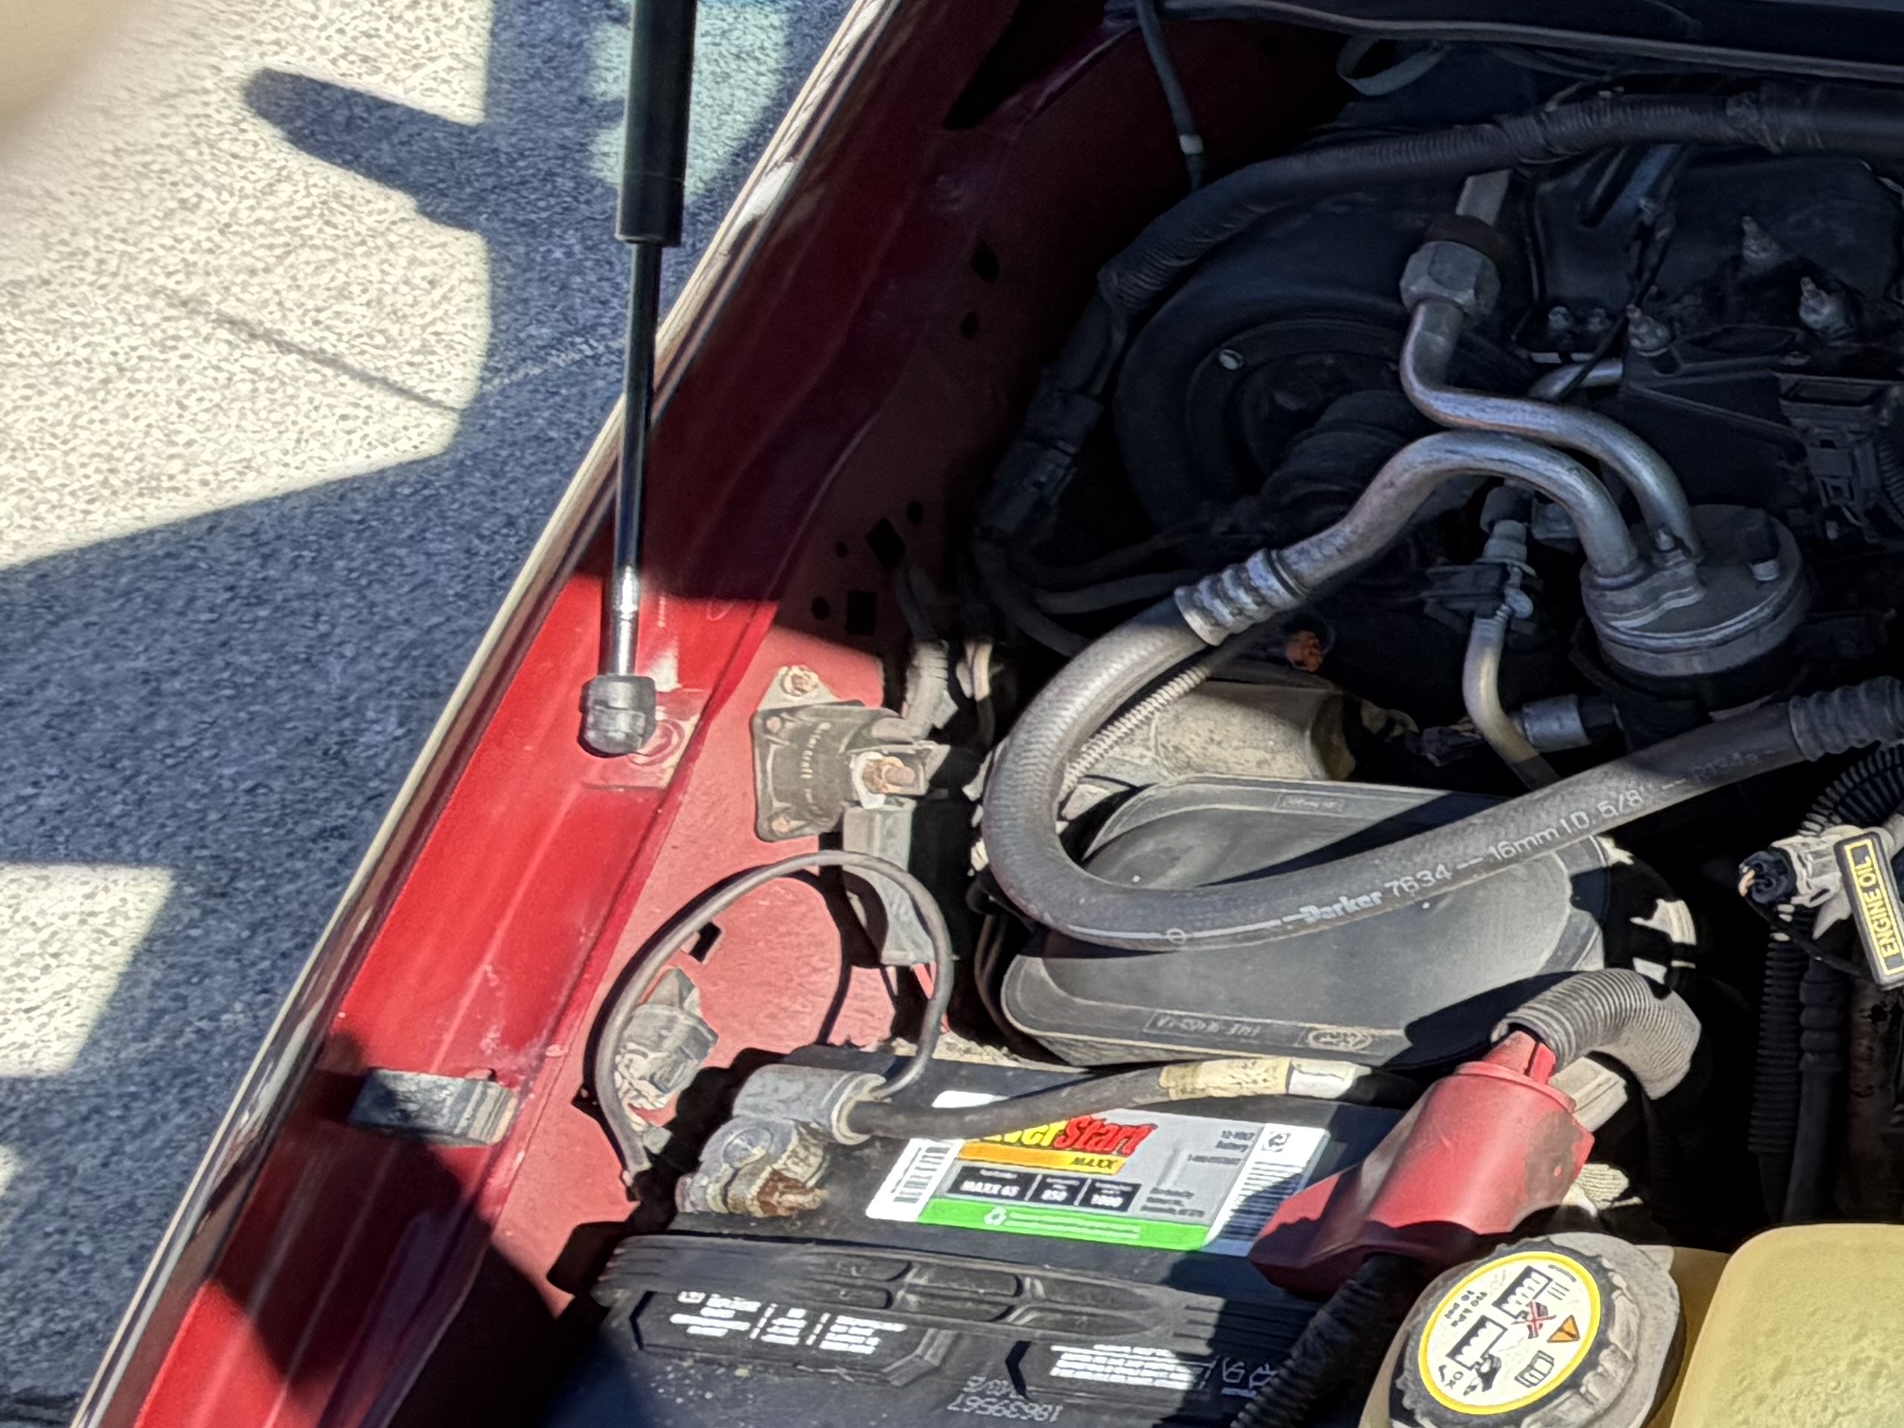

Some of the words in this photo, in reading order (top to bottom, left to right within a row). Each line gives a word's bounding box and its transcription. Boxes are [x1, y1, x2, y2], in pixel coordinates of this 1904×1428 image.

[1297, 887, 1384, 925] Parker
[1383, 861, 1454, 901] 7634
[1489, 826, 1559, 863] 16mm
[1854, 855, 1877, 887] OIL
[1863, 887, 1901, 959] ENGINE
[1071, 1156, 1119, 1170] MAXX
[959, 1179, 1001, 1195] MAXX
[1040, 1189, 1068, 1202] 850
[1090, 1194, 1125, 1208] 1000
[1443, 1371, 1465, 1390] OK
